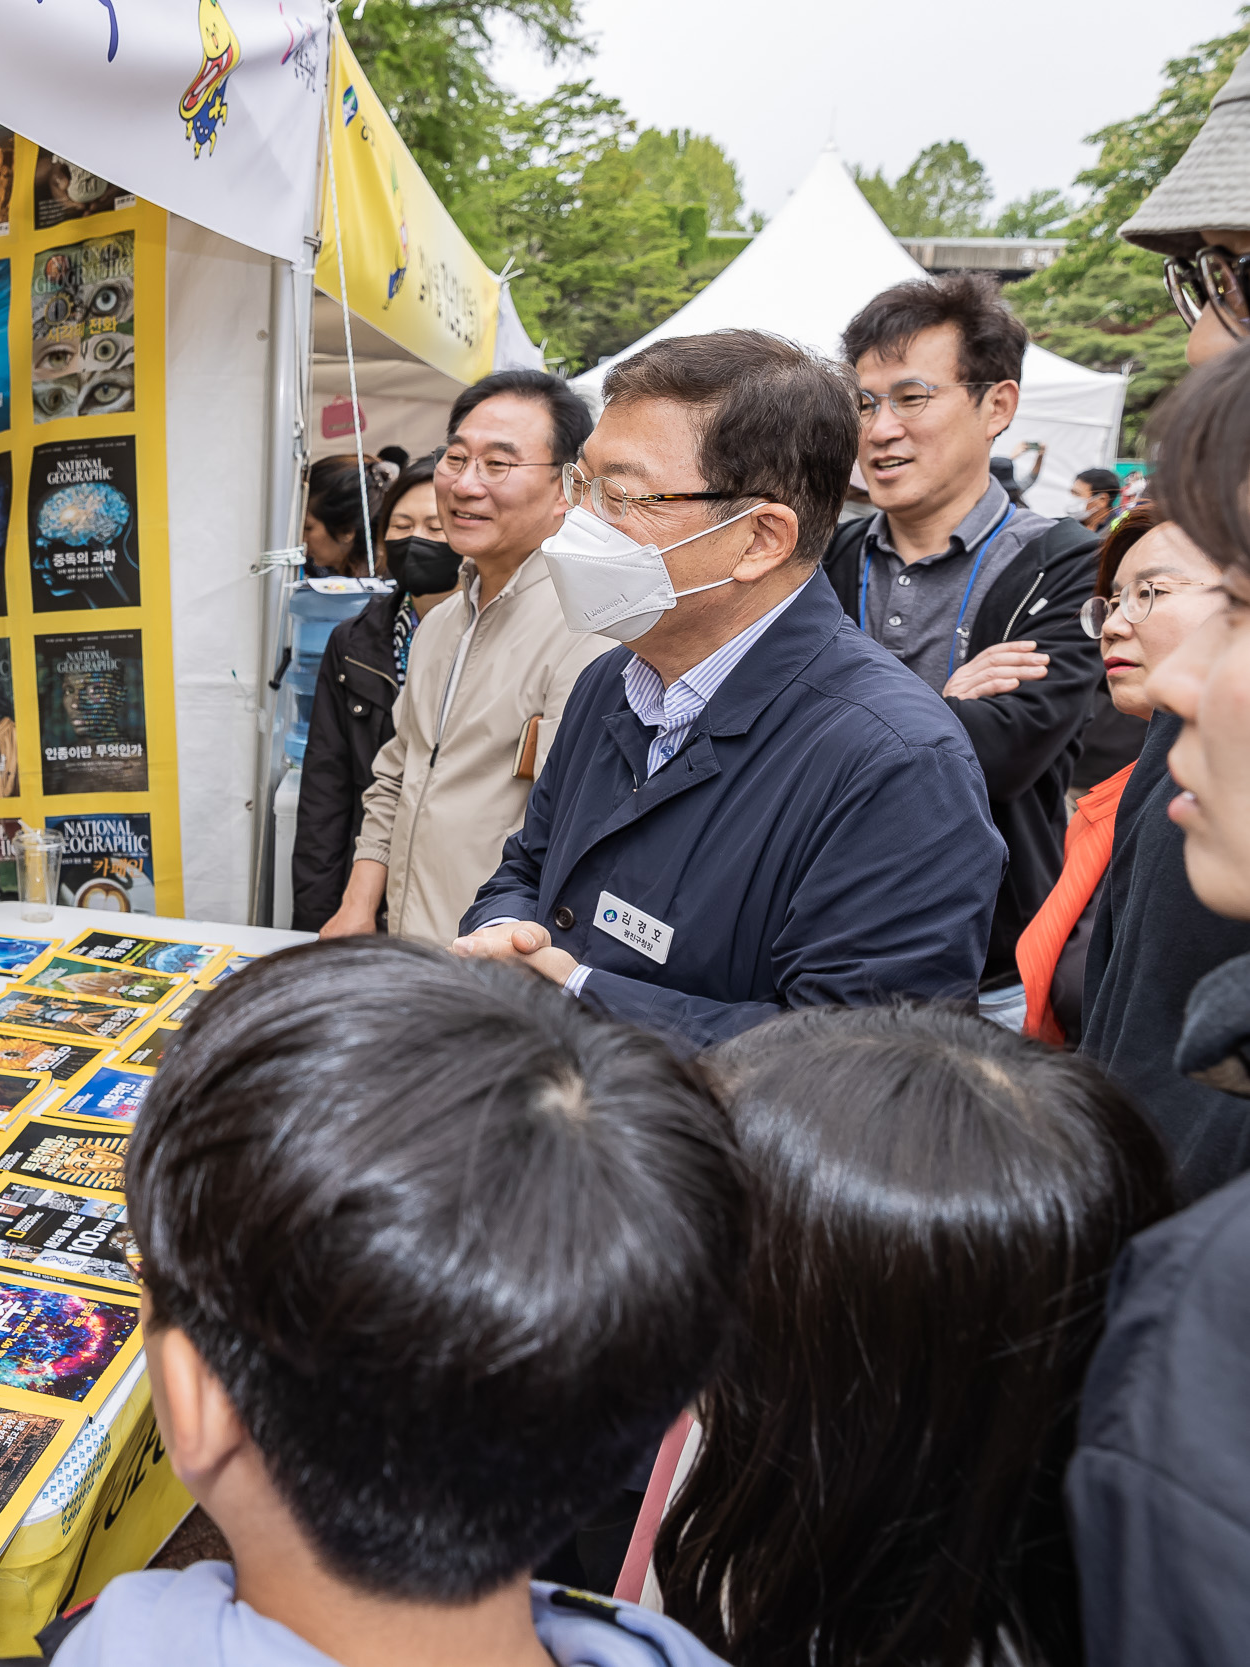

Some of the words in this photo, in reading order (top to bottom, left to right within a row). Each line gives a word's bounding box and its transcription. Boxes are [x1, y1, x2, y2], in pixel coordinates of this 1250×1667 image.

[88, 315, 118, 334] 진화
[56, 457, 103, 472] NATIONAL
[47, 468, 114, 485] GEOGRAPHIC
[53, 551, 89, 568] 중독의
[91, 549, 117, 565] 과학
[66, 650, 110, 662] NATIONAL
[56, 658, 120, 674] GEOGRAPHIC
[96, 744, 144, 758] 무엇인가
[63, 820, 134, 837] NATIONAL
[92, 856, 144, 878] 카페인
[624, 929, 654, 952] 광진구청장
[43, 1228, 73, 1250] 세상을
[62, 1214, 86, 1230] 바꾼
[66, 1220, 117, 1254] 100가지
